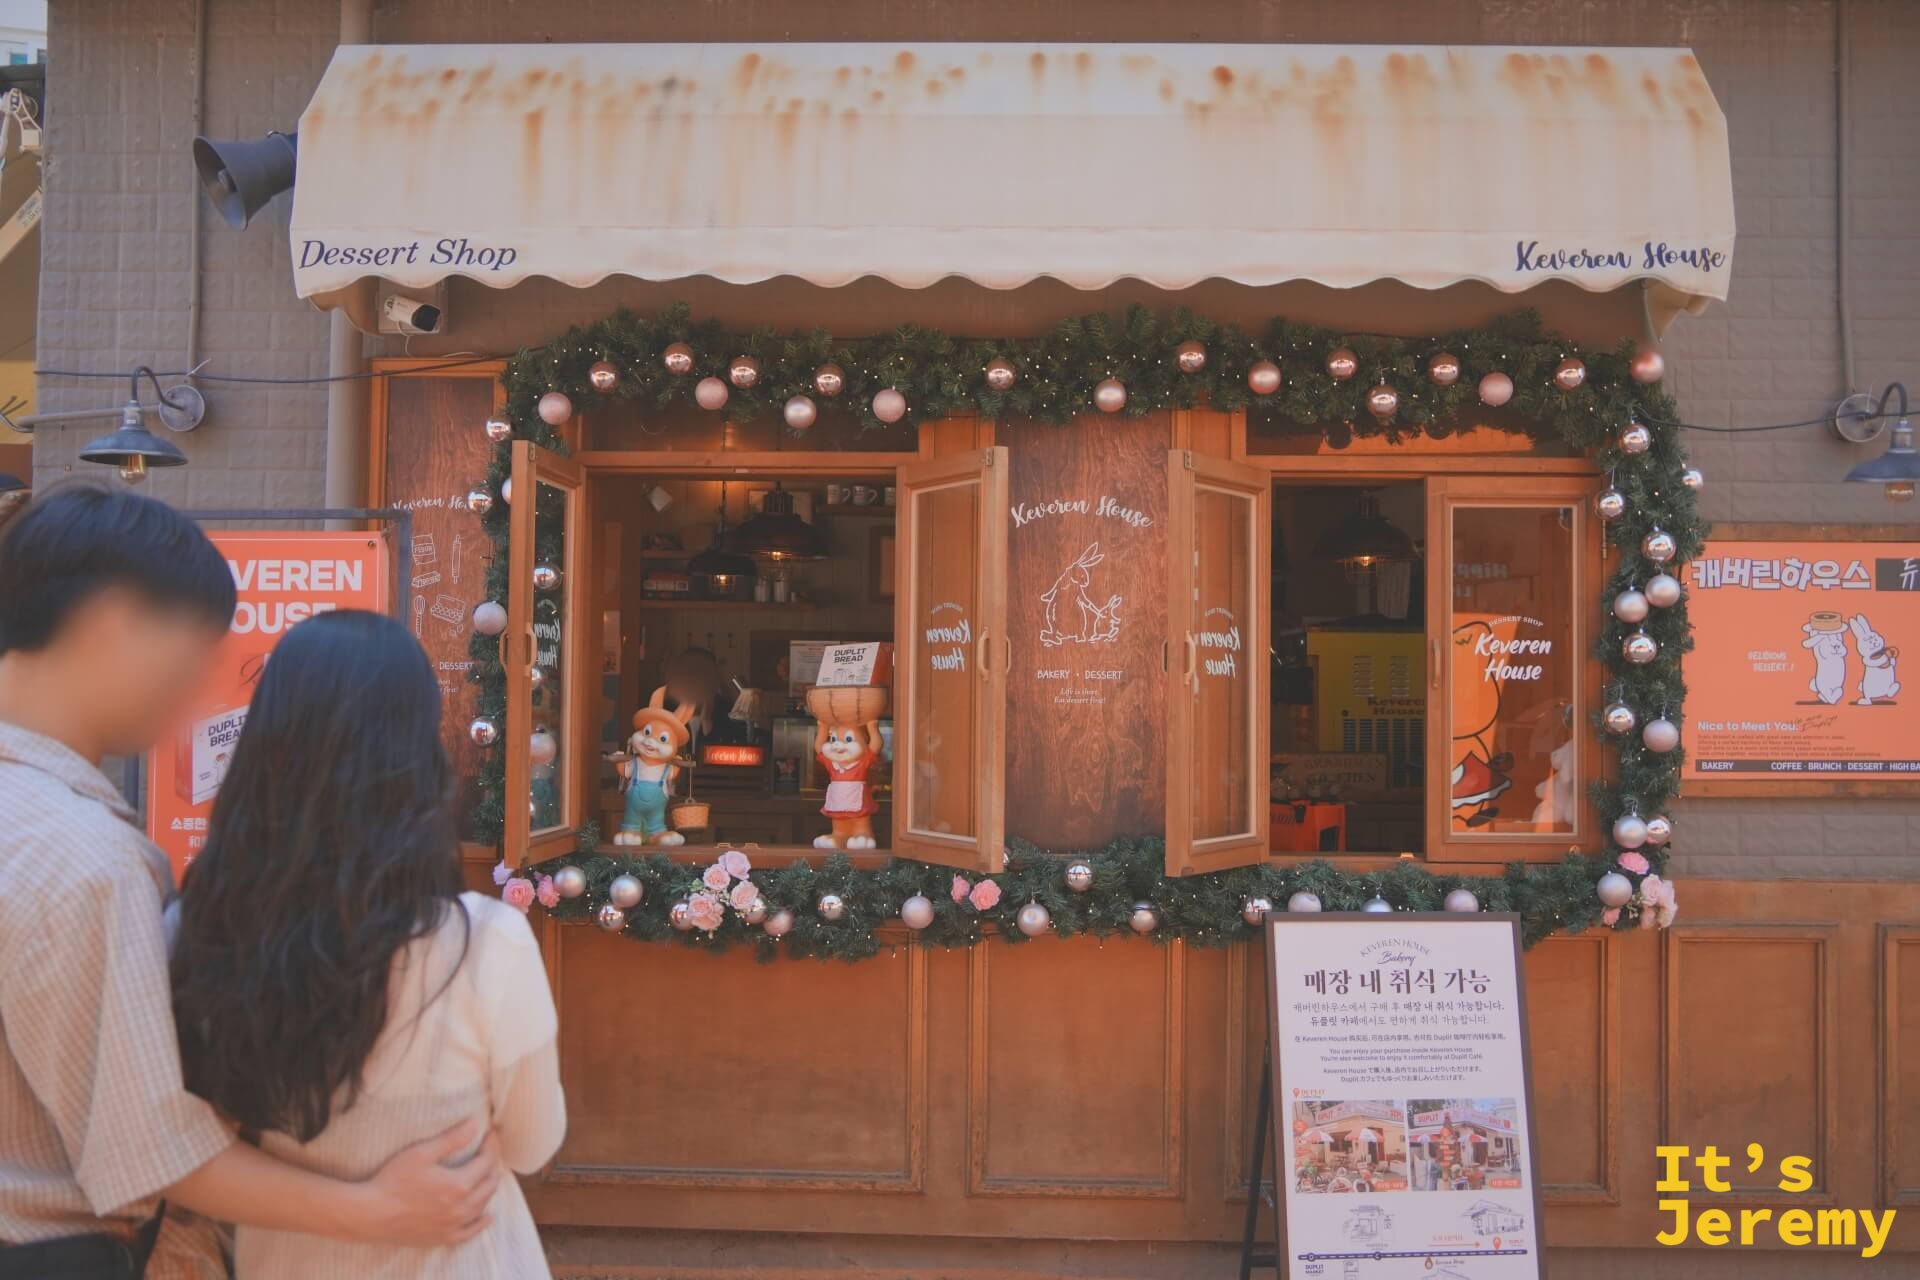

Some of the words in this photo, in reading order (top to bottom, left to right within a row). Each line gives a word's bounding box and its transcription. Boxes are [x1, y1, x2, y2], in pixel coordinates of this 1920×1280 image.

[300, 239, 418, 268] Dessert
[429, 237, 517, 271] Shop
[1515, 240, 1631, 272] Keveren
[1642, 241, 1726, 272] House
[1010, 497, 1089, 529] Keveren
[1095, 495, 1154, 528] House
[1690, 555, 1873, 592] 캐버린하우스
[230, 601, 336, 634] OUS
[1488, 615, 1521, 627] DESSERT
[1523, 616, 1544, 628] SHOP
[834, 647, 867, 657] DUPLIT
[1474, 632, 1552, 657] Keveren
[834, 655, 864, 664] BREAD
[1484, 657, 1543, 682] House
[1037, 670, 1071, 680] BAKERY
[1085, 670, 1123, 680] DESSERT
[1697, 721, 1724, 732] Nice
[1727, 722, 1738, 731] to
[1741, 721, 1772, 732] Meet
[1774, 721, 1799, 732] You.
[1701, 761, 1734, 770] BAKERY
[1771, 762, 1803, 770] COFFEE
[1808, 762, 1842, 771] BRUNCH
[1847, 762, 1884, 771] DESSERT
[1889, 762, 1910, 771] HIGH
[1303, 968, 1352, 995] 매장
[1359, 969, 1382, 995] 내
[1389, 968, 1435, 995] 취식
[1444, 968, 1491, 995] 가능
[1403, 1000, 1421, 1012] 매장
[1424, 1000, 1433, 1012] 내
[1436, 1000, 1454, 1011] 취식
